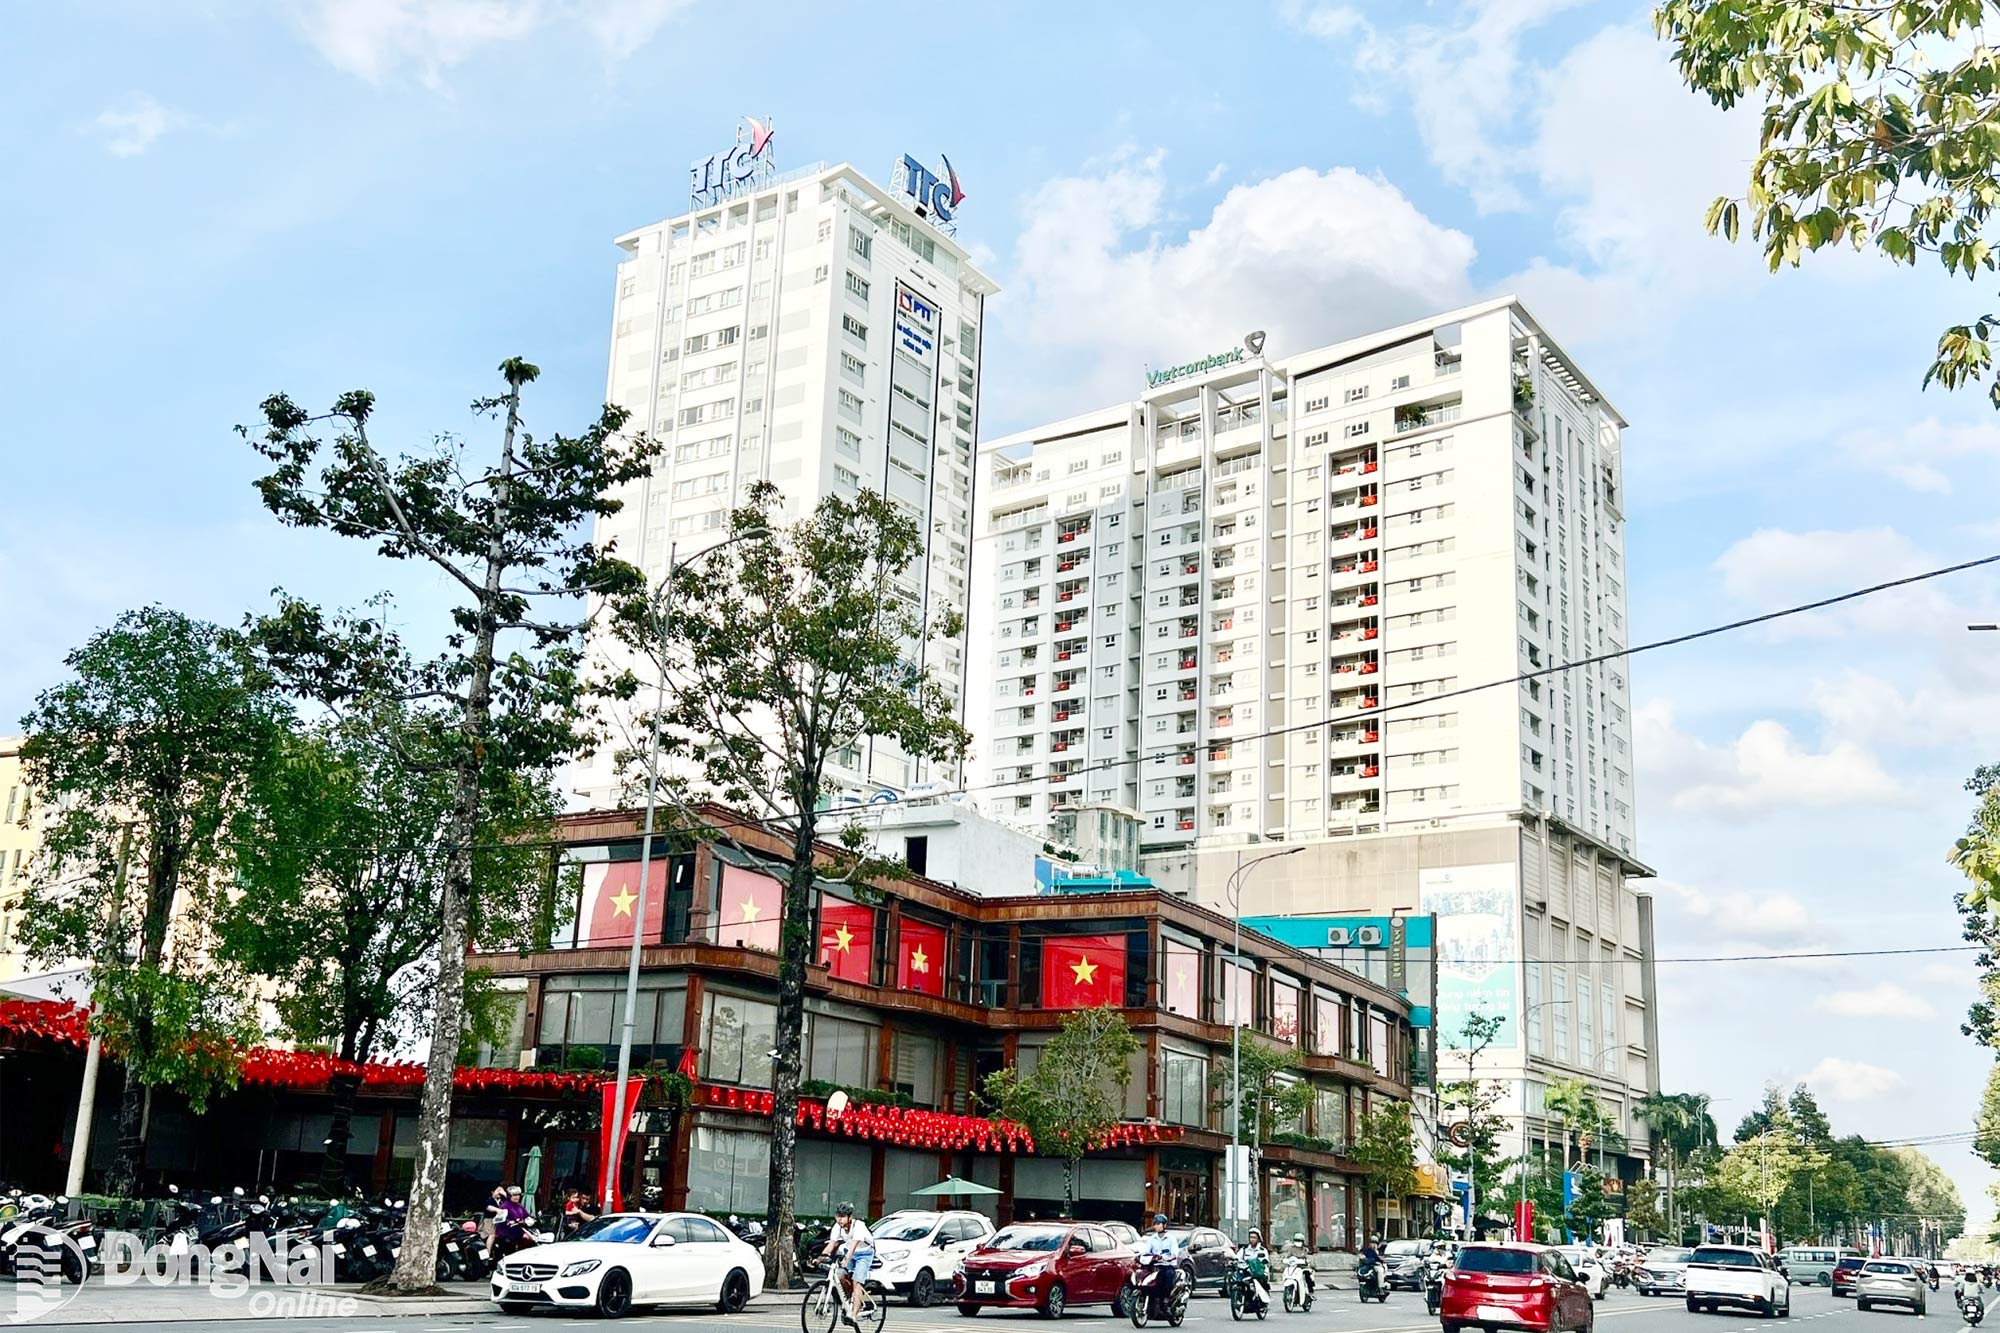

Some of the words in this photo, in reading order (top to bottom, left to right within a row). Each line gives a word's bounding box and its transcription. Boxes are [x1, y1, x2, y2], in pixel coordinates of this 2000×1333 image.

[690, 143, 755, 194] TTC
[903, 152, 953, 222] TTC
[1147, 347, 1244, 385] Vietcombank
